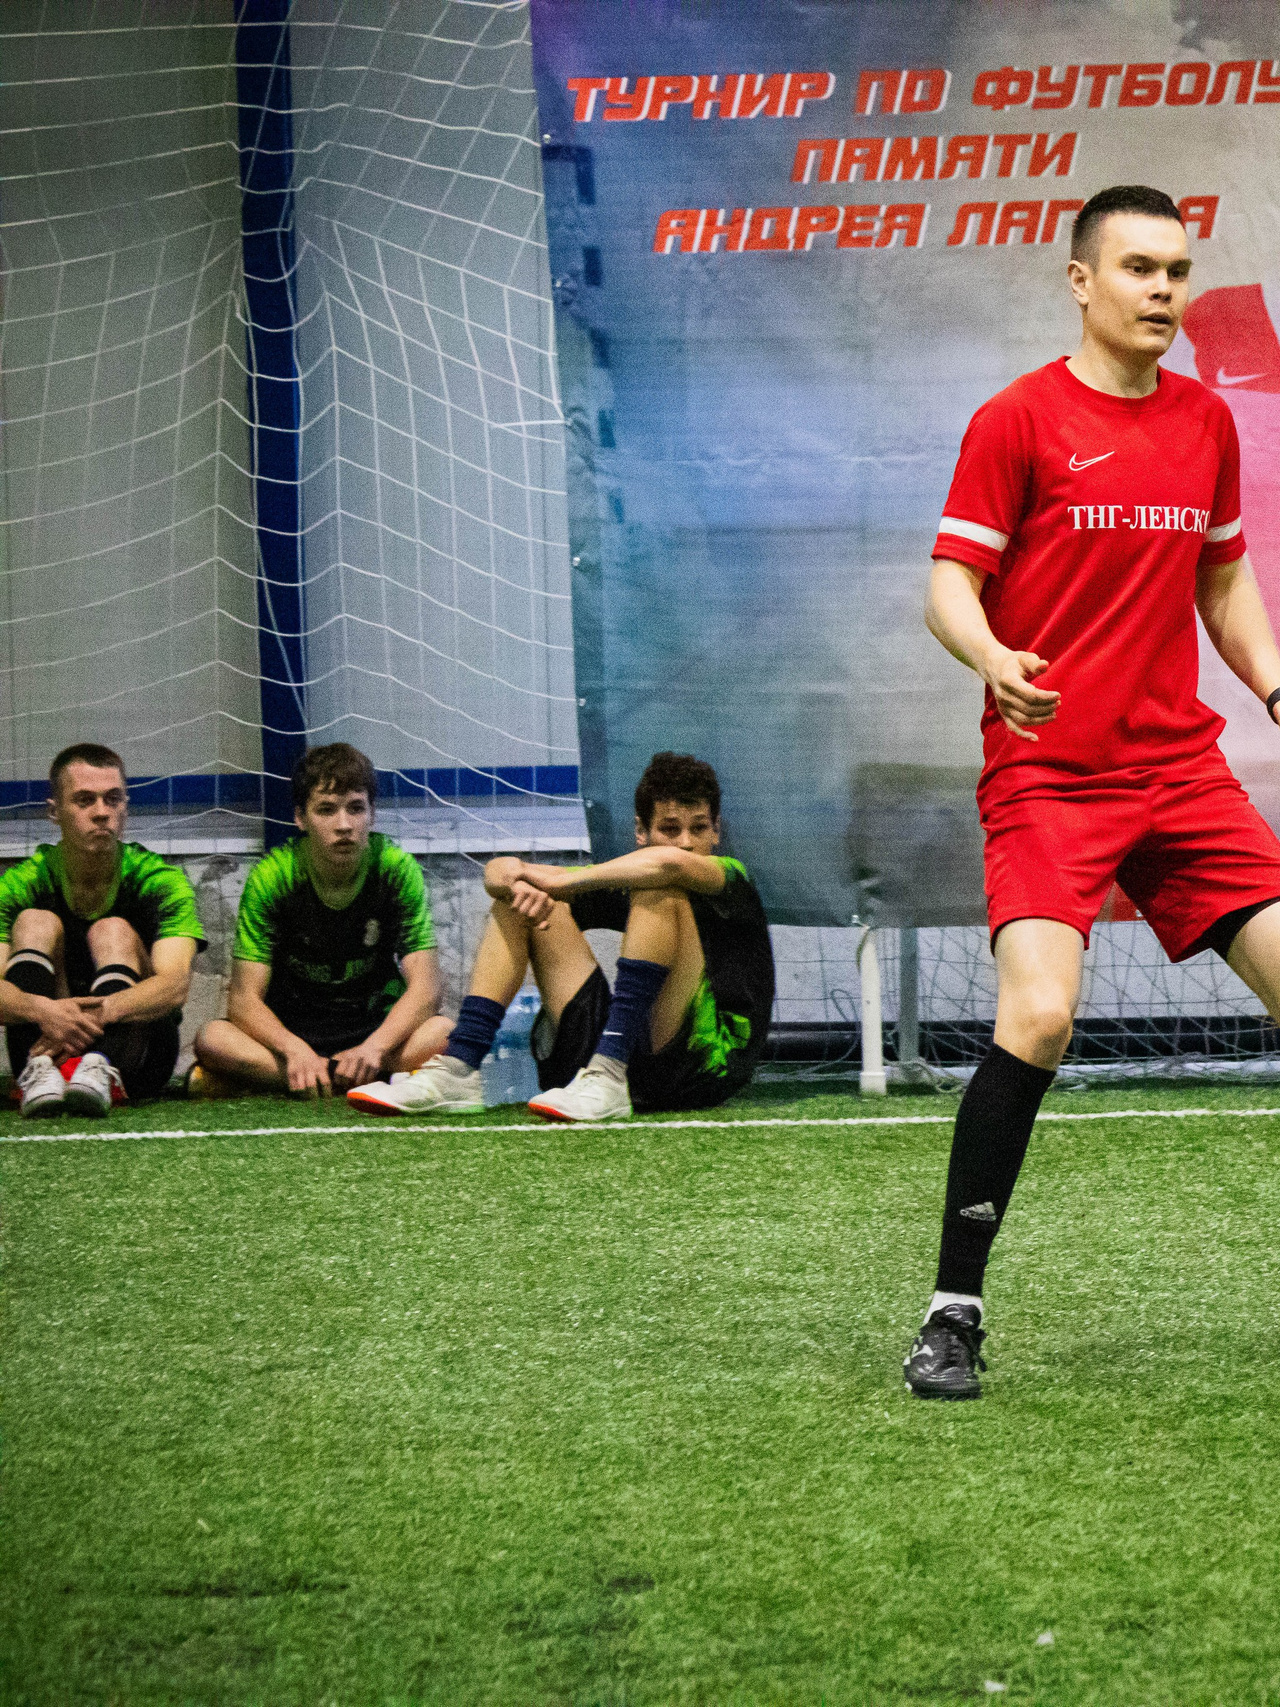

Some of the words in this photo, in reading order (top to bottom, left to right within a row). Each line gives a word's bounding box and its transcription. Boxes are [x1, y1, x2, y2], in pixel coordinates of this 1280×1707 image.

[567, 71, 837, 122] ТУРНИР
[855, 69, 952, 115] ПО
[790, 132, 1081, 183] ПАМЯТИ
[653, 203, 928, 254] АНДРЕЯ
[946, 195, 1222, 246] ЛАГА
